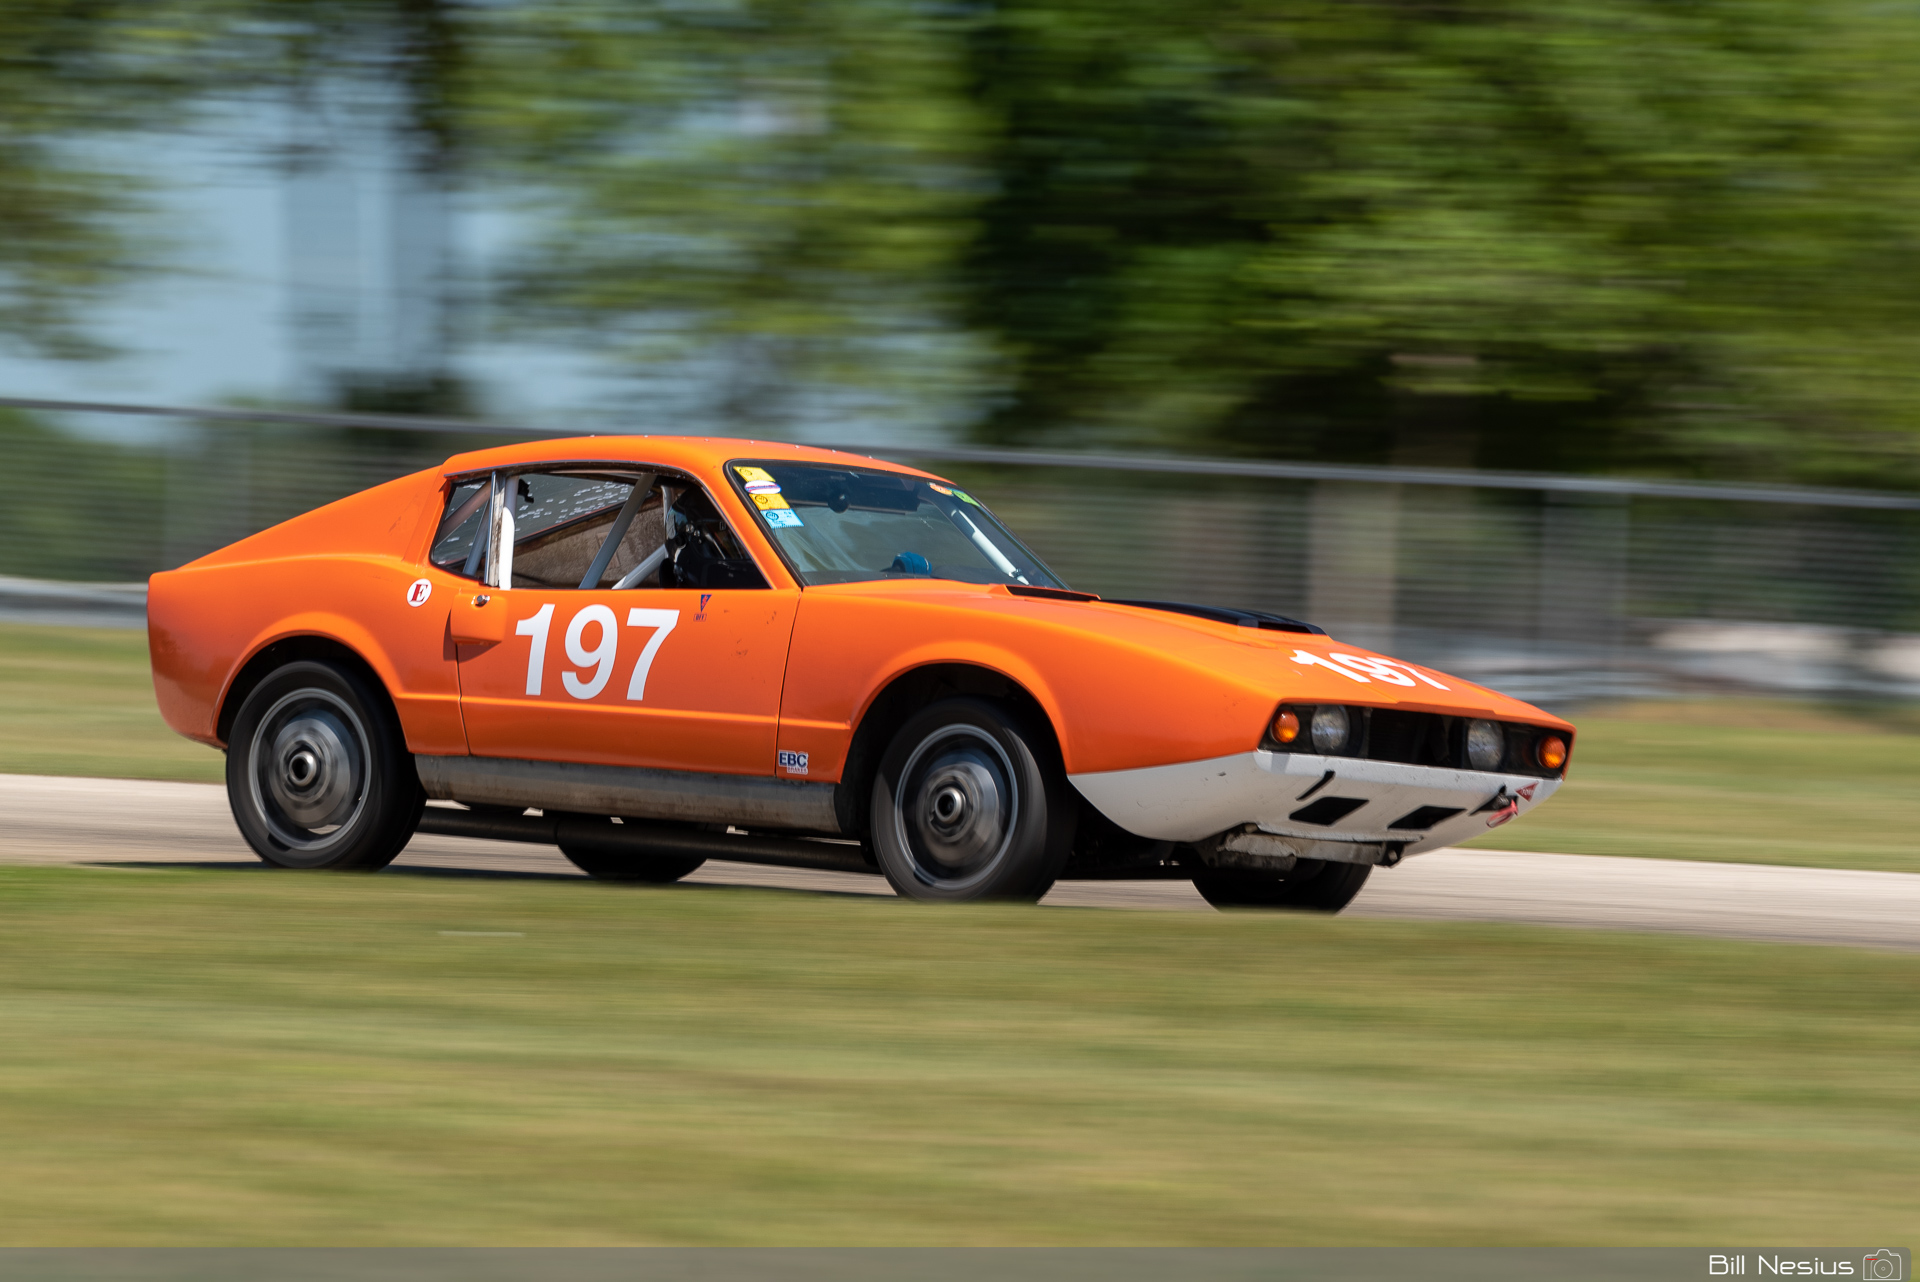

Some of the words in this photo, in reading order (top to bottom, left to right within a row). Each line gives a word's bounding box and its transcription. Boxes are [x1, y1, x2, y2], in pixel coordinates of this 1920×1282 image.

[409, 583, 428, 602] E
[515, 603, 680, 701] 197
[1289, 649, 1452, 691] 197
[779, 752, 807, 768] EBC
